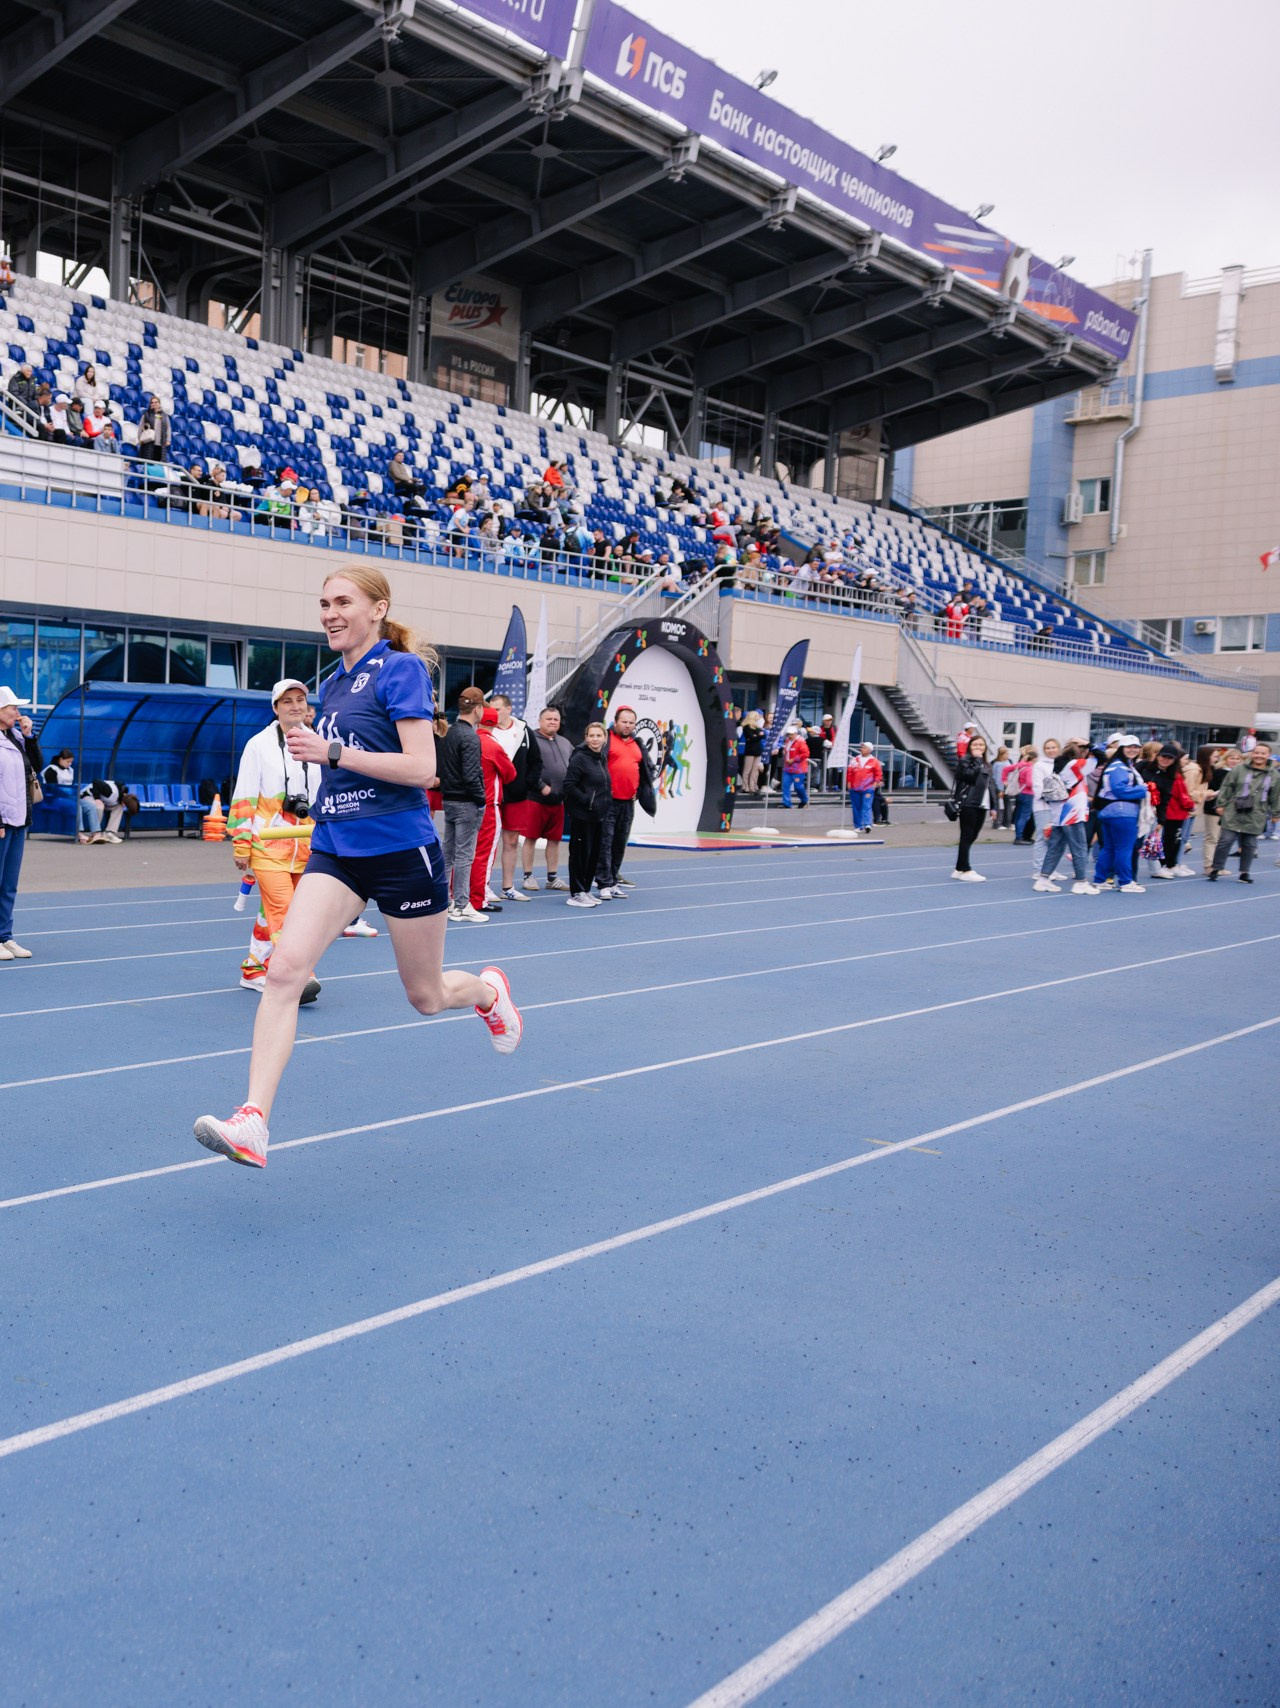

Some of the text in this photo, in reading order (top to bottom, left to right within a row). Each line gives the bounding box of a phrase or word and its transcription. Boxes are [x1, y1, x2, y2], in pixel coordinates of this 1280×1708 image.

[643, 52, 688, 100] ПСБ
[708, 88, 915, 229] Банк настоящих чемпионов
[1084, 310, 1131, 346] psbank.ru
[661, 621, 687, 636] КОМОС
[336, 788, 377, 804] КОМОС
[410, 899, 432, 909] asics
